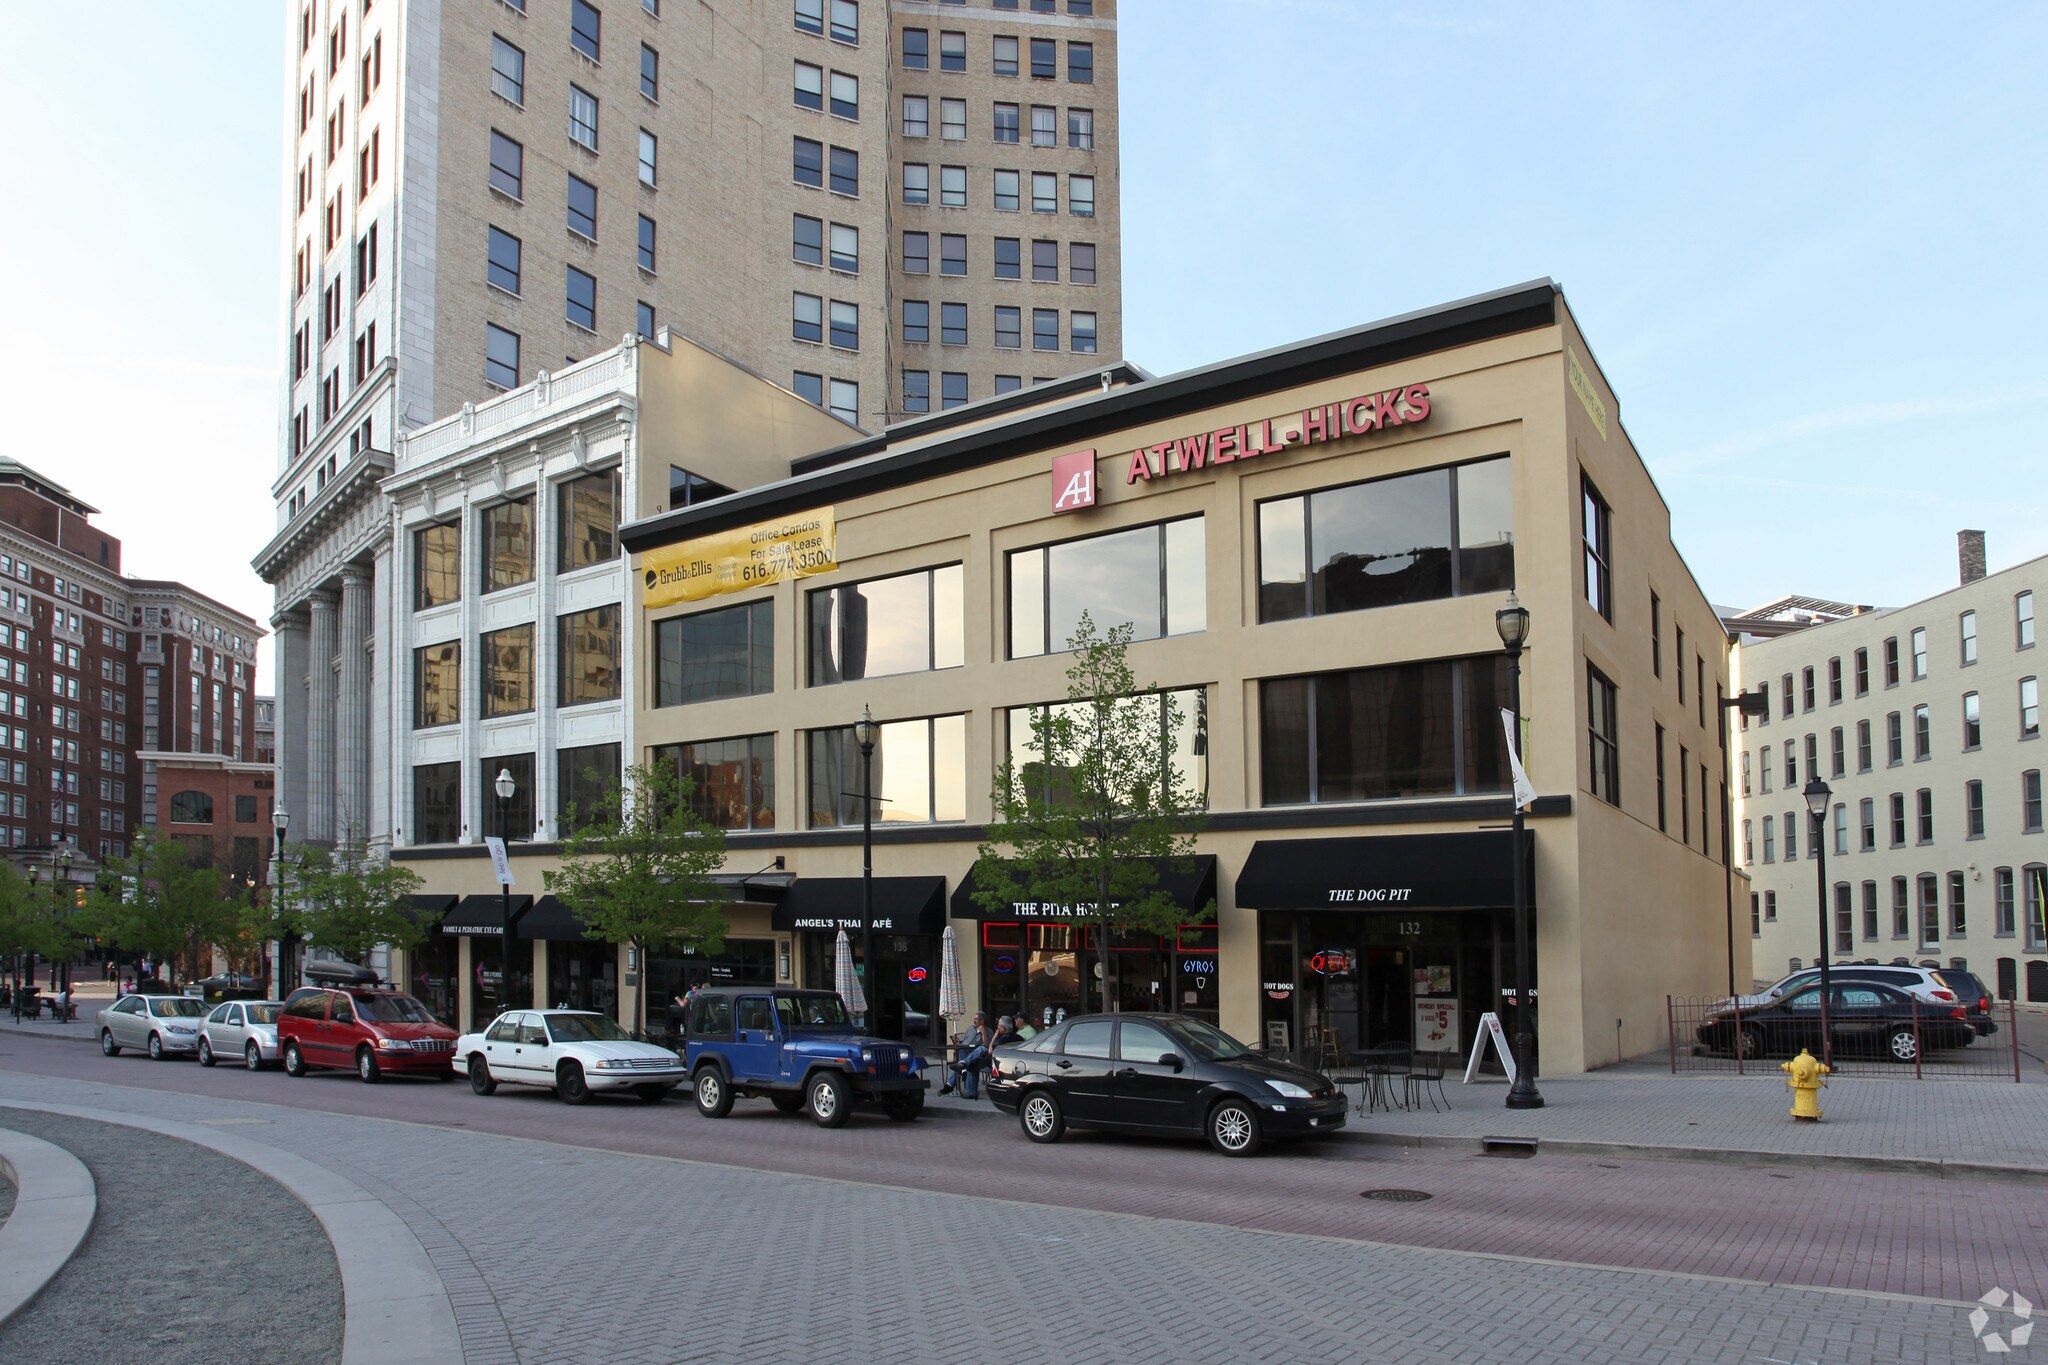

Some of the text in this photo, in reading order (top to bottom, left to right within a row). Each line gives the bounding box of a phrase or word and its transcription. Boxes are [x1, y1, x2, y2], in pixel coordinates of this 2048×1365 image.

[1126, 383, 1431, 485] ATWELL-HICKS
[750, 520, 820, 544] Office Condos
[750, 549, 767, 561] For
[743, 548, 832, 581] 616.774.3500
[1328, 888, 1412, 901] THE DOG PIT
[1013, 902, 1038, 916] THE
[1042, 902, 1072, 916] PITA
[794, 917, 893, 929] ANGEL'S THAI AFÉ
[1400, 922, 1420, 934] 132
[1183, 959, 1214, 973] GYROS
[1310, 954, 1351, 972] OPEN
[908, 969, 927, 980] OPEN
[1264, 982, 1276, 990] HOT
[1502, 988, 1517, 996] HOT
